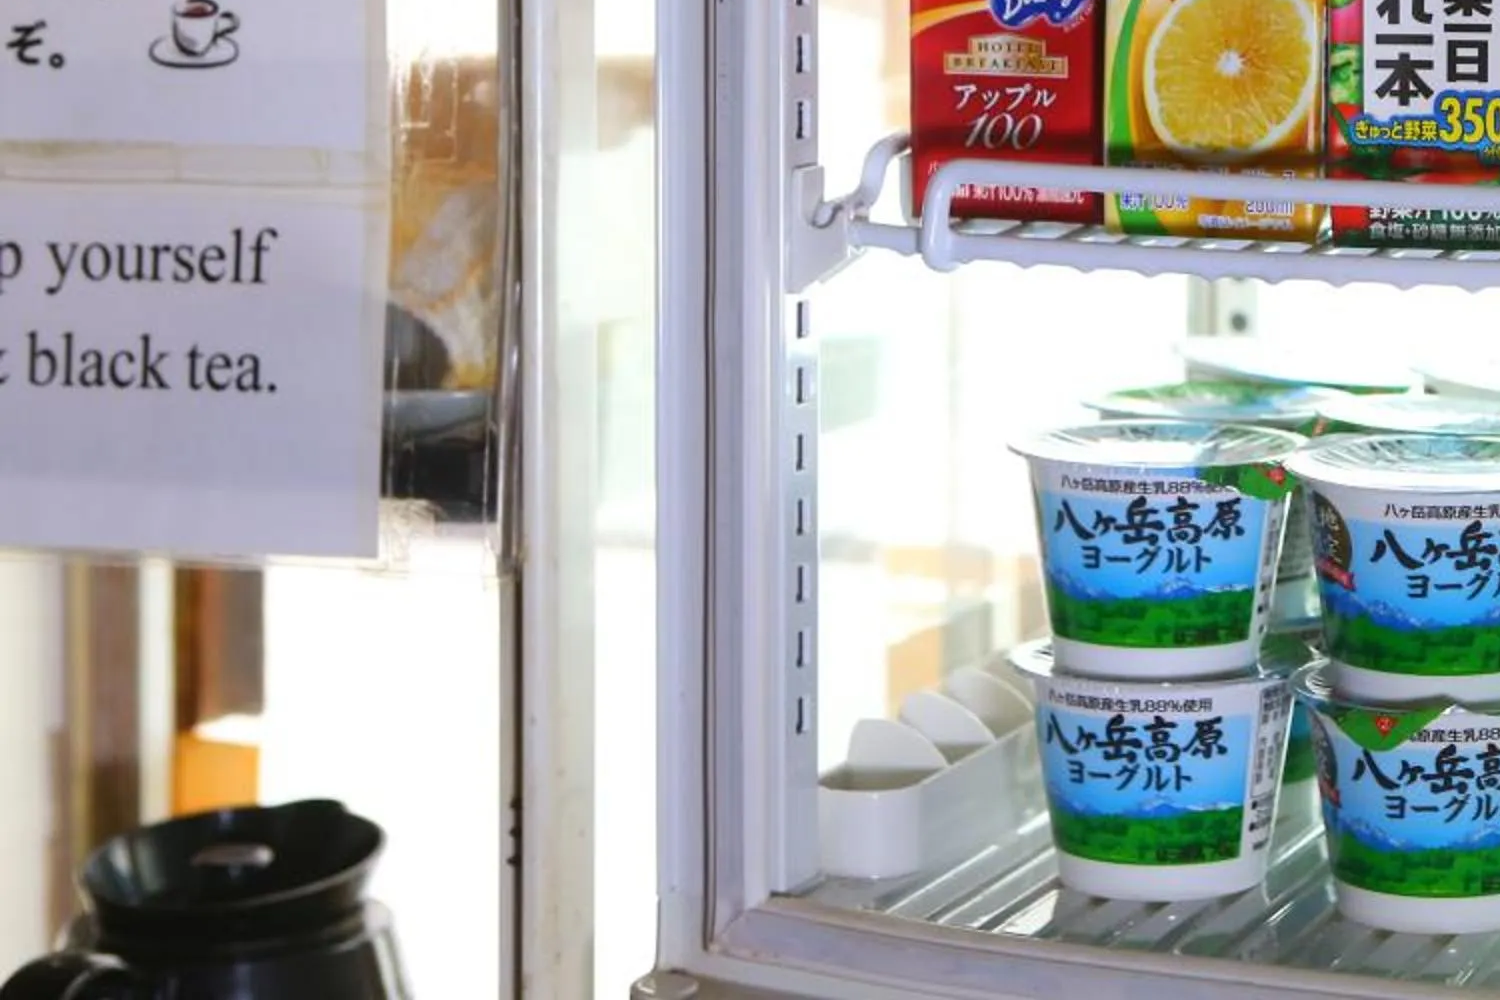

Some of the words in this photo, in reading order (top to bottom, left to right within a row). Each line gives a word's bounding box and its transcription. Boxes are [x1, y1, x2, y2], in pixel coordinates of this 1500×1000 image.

[953, 56, 1057, 72] BREAKFAST
[977, 41, 1041, 54] HOTEL
[953, 83, 1057, 110] アップル
[965, 112, 1043, 150] 100
[45, 227, 279, 295] yourself
[27, 331, 170, 390] black
[186, 343, 278, 393] tea.
[1054, 496, 1246, 547] 八ヶ岳高原
[1082, 545, 1212, 574] ヨーグルト
[1047, 713, 1228, 763] 八ヶ岳高原
[1067, 760, 1192, 792] ヨーグルト
